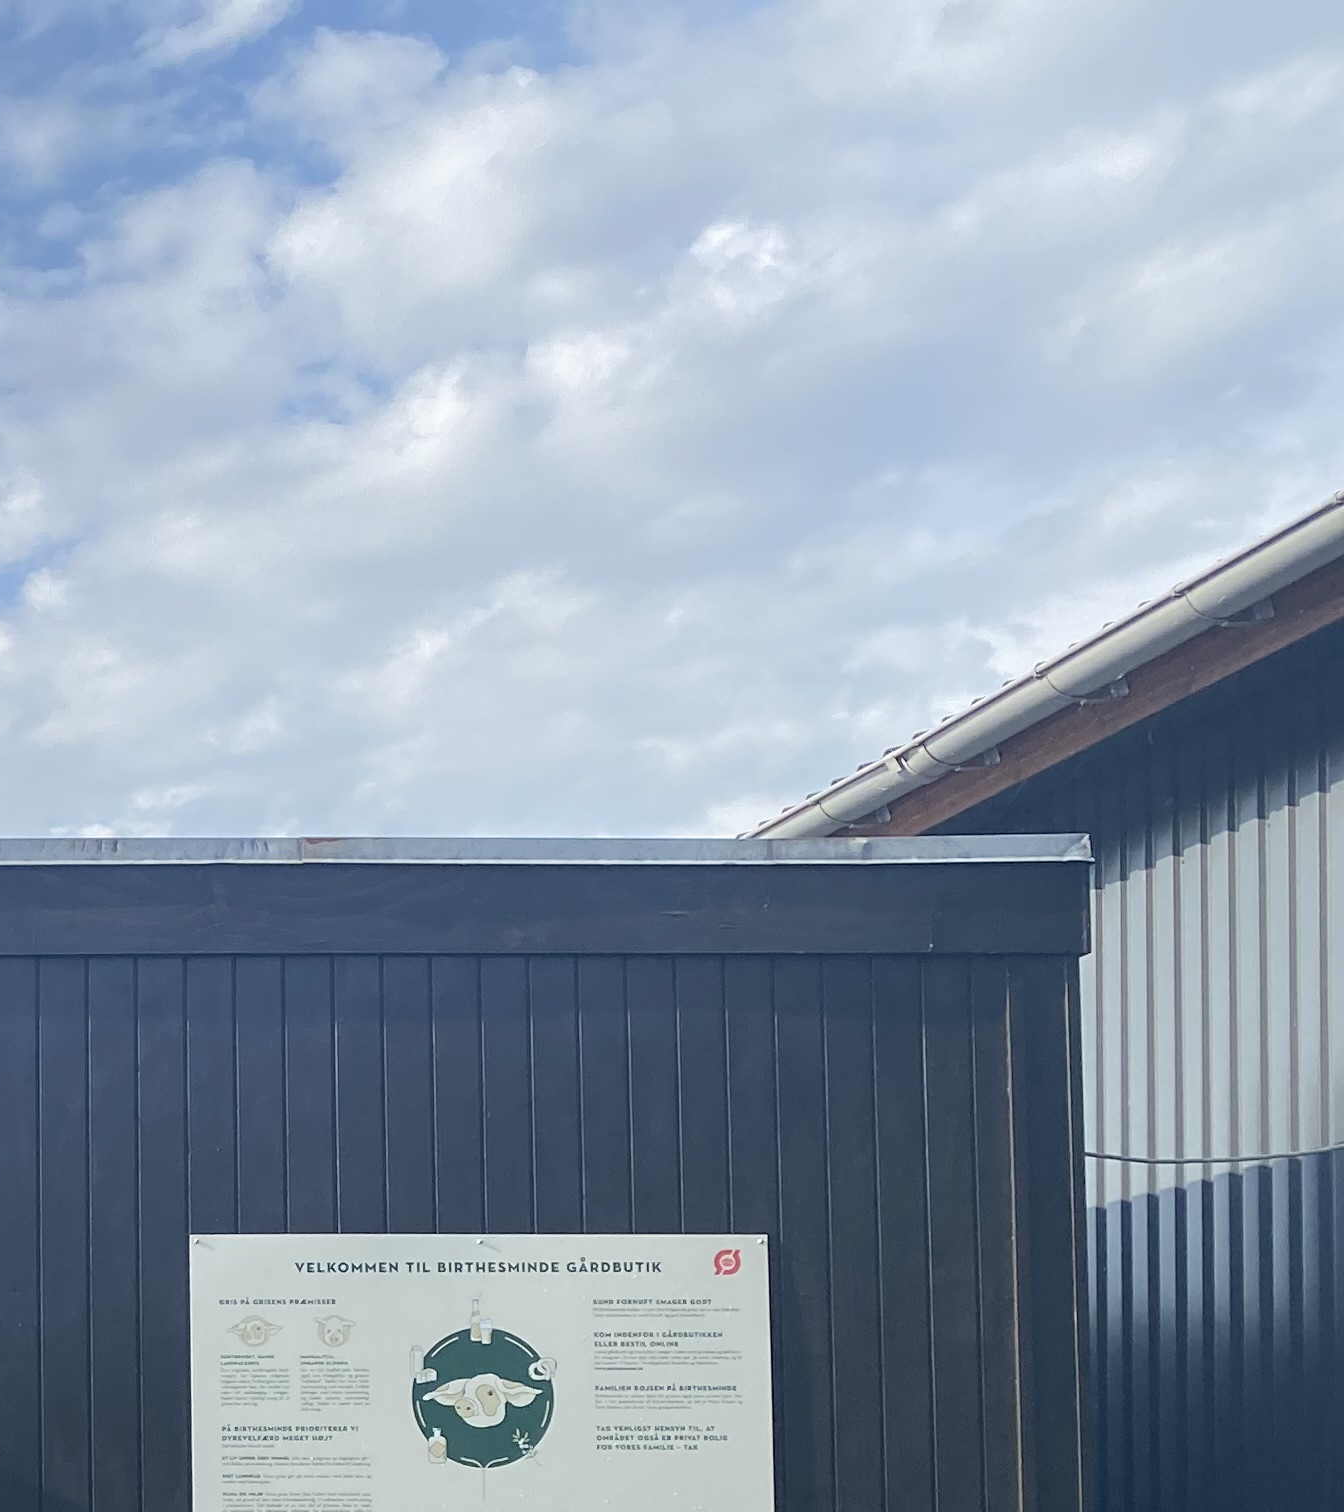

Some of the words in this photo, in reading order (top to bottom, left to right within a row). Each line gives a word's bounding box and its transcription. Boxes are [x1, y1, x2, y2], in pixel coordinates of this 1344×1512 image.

[294, 1262, 399, 1273] VELKOMMEN
[405, 1262, 431, 1273] TIL
[437, 1262, 560, 1273] BIRTHESMINDE
[566, 1257, 662, 1273] GÅRDBUTIK
[240, 1297, 250, 1305] PÅ
[221, 1424, 231, 1432] PÅ
[597, 1433, 634, 1441] OMRÅDET
[637, 1433, 659, 1441] OGSÅ
